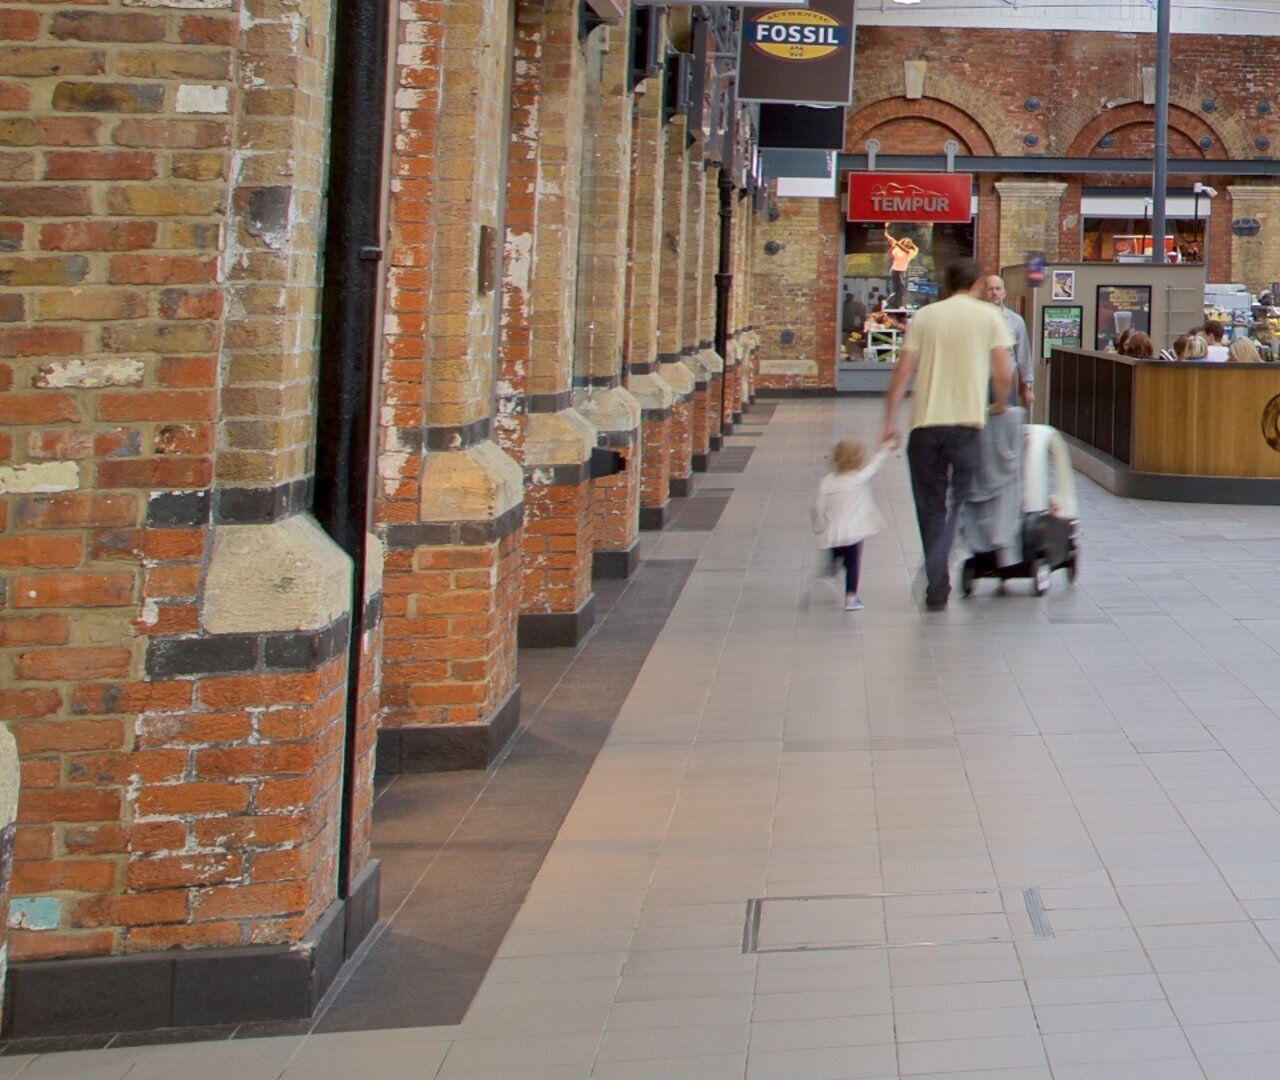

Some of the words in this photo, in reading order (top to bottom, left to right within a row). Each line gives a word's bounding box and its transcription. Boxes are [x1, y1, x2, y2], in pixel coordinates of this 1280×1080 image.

[767, 11, 831, 23] AUTHENTIC
[756, 24, 839, 44] FOSSIL
[871, 196, 949, 212] TEMPUR
